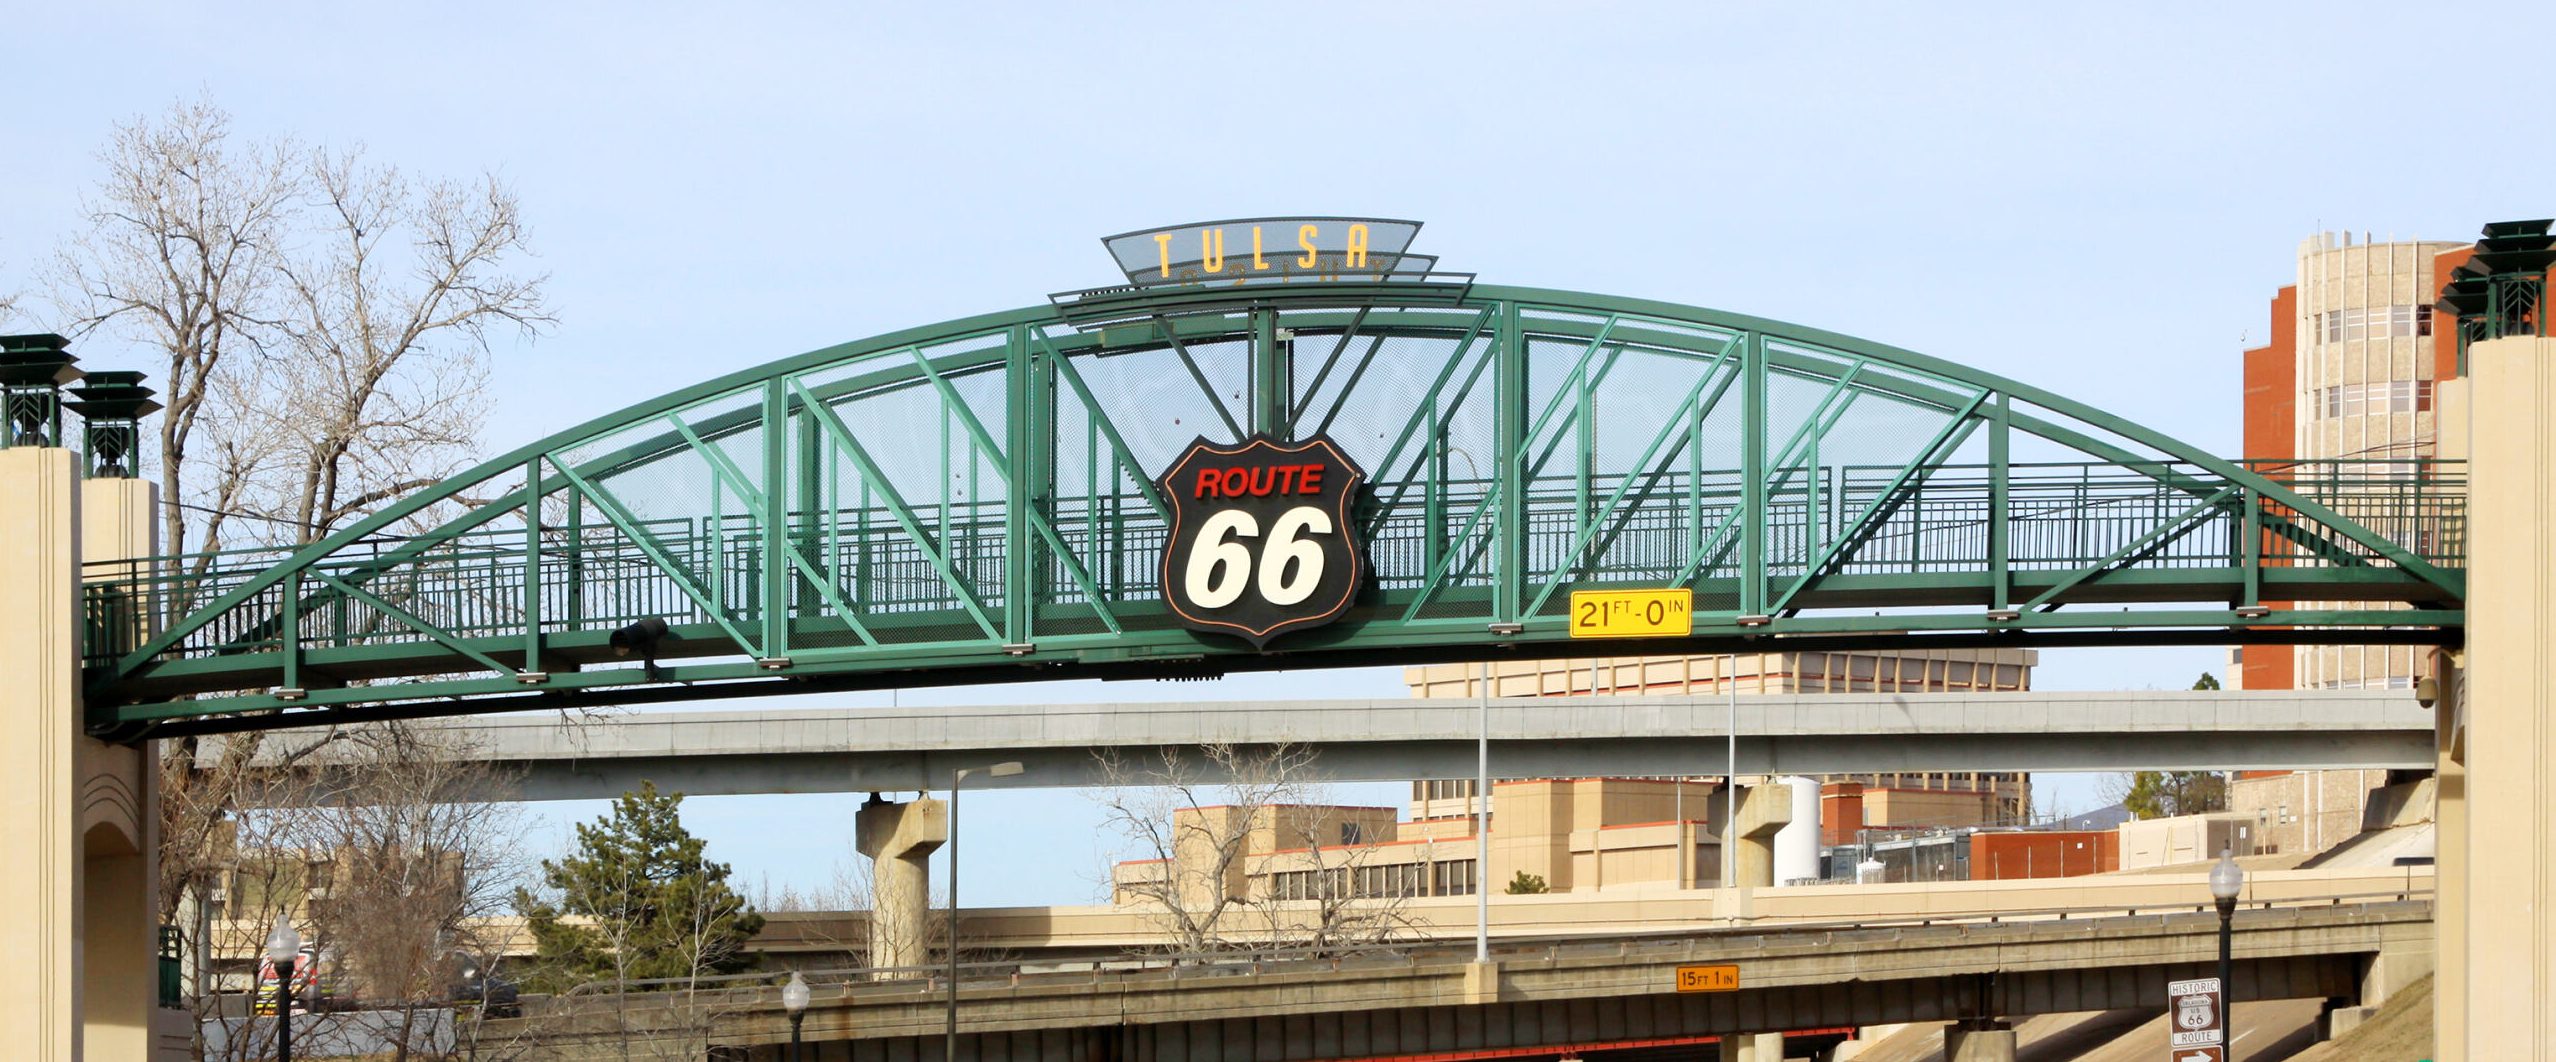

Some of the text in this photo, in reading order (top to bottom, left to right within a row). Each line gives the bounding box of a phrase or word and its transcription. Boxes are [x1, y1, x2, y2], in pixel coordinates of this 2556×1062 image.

[1154, 224, 1369, 279] TULSA
[1194, 463, 1325, 498] ROUTE
[1185, 506, 1333, 609] 66
[2172, 982, 2216, 994] HISTORIC
[2188, 1014, 2203, 1025] 66
[2181, 1031, 2212, 1043] ROUTE
